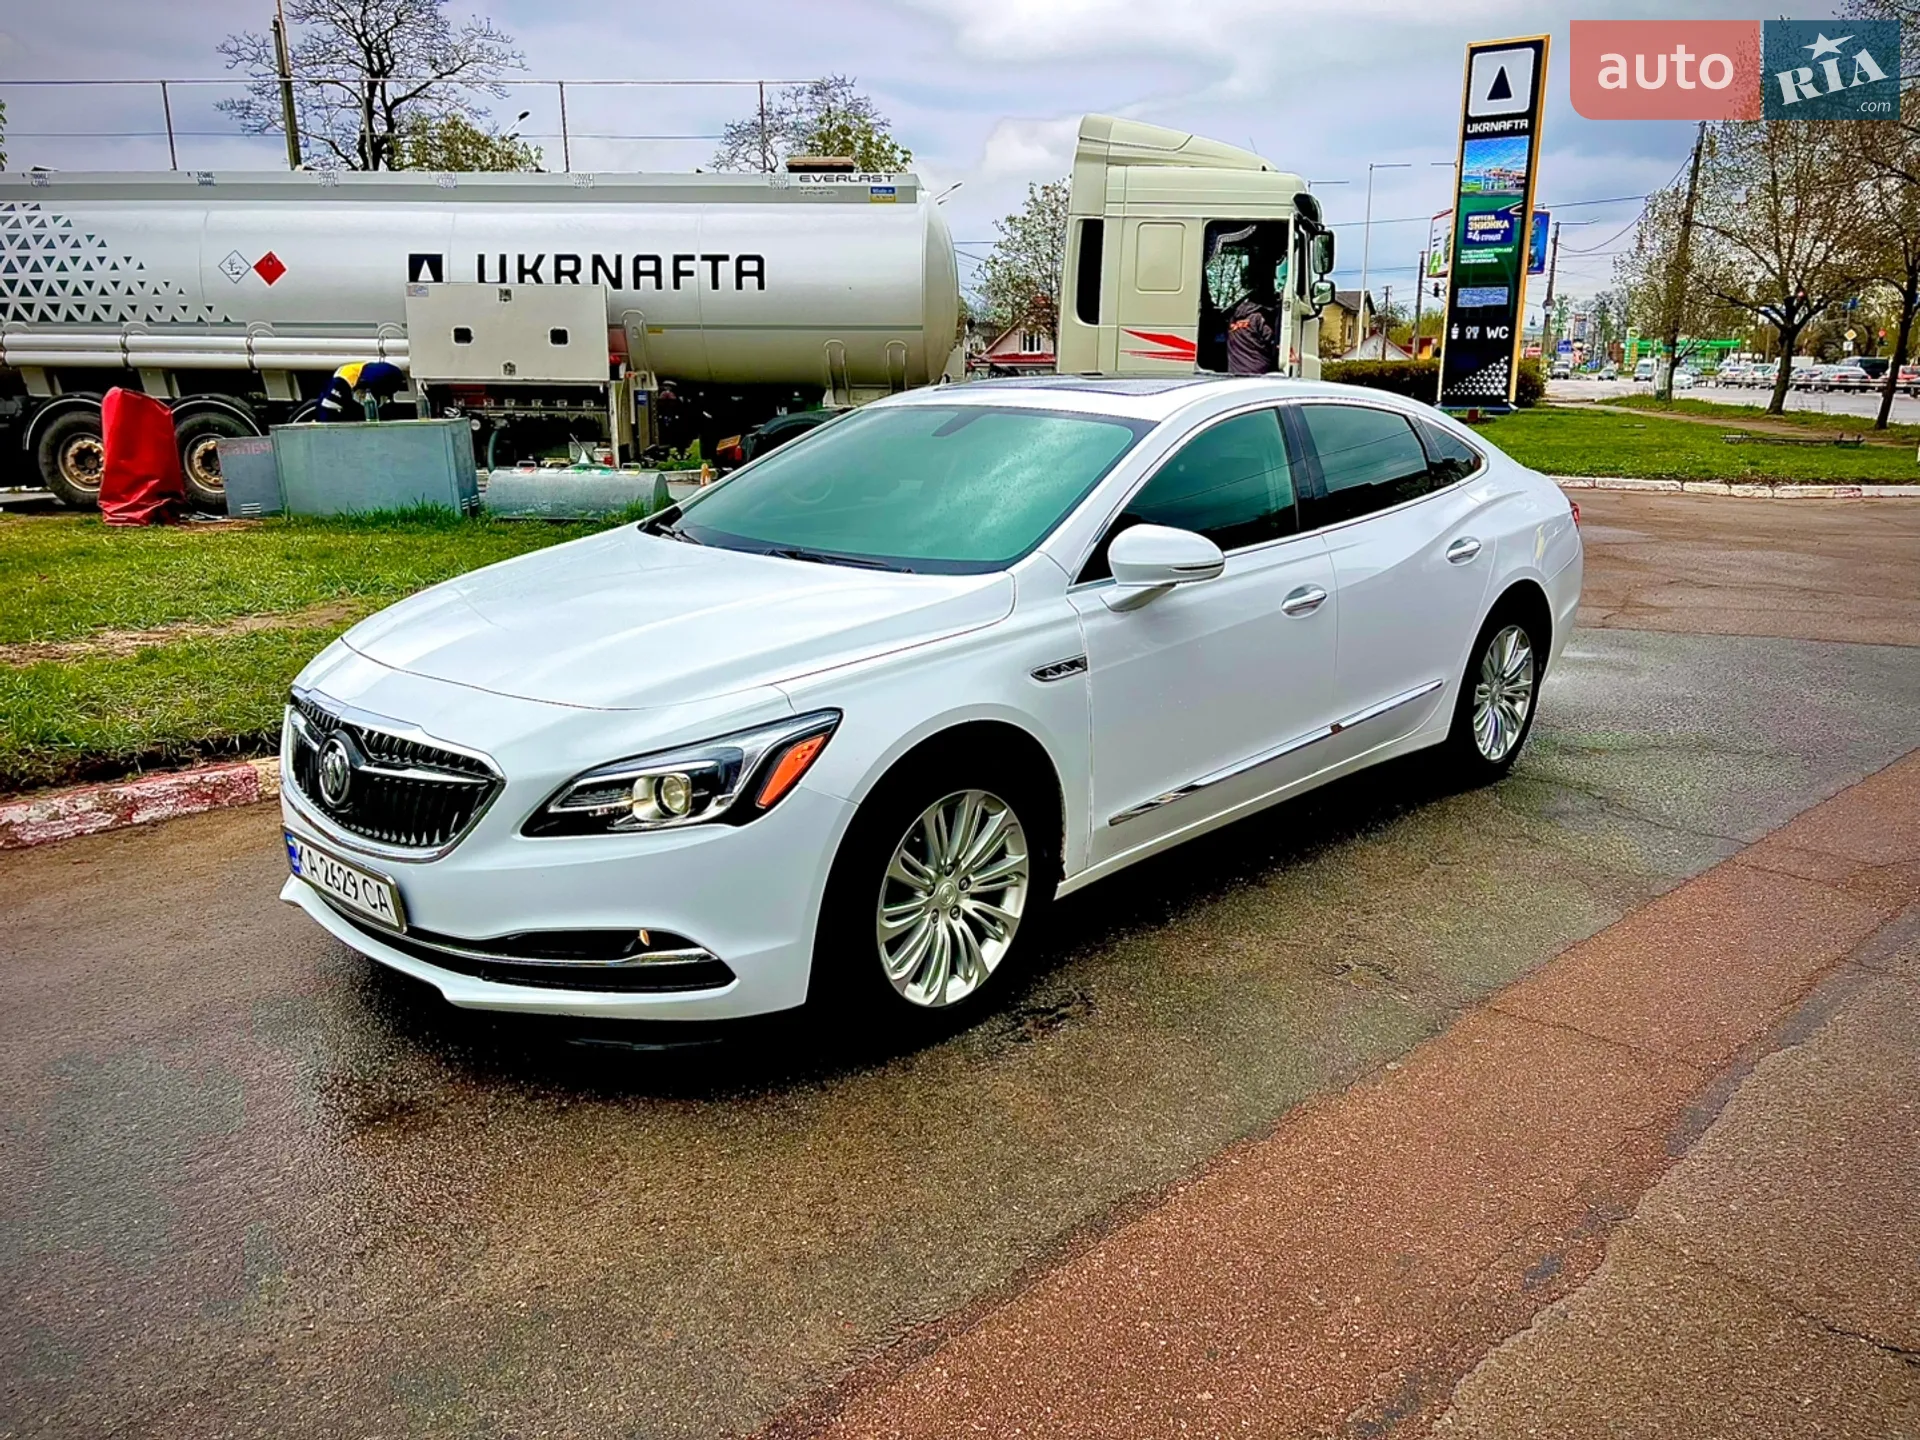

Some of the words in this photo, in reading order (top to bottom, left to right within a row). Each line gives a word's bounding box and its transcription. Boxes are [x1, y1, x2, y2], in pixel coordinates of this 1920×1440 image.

[1467, 119, 1529, 134] UKRNAFTA
[799, 174, 895, 183] EVERLAST
[477, 253, 766, 290] UKRNAFTA
[1486, 326, 1509, 339] WC
[319, 857, 359, 901] 2629
[362, 878, 392, 917] CA
